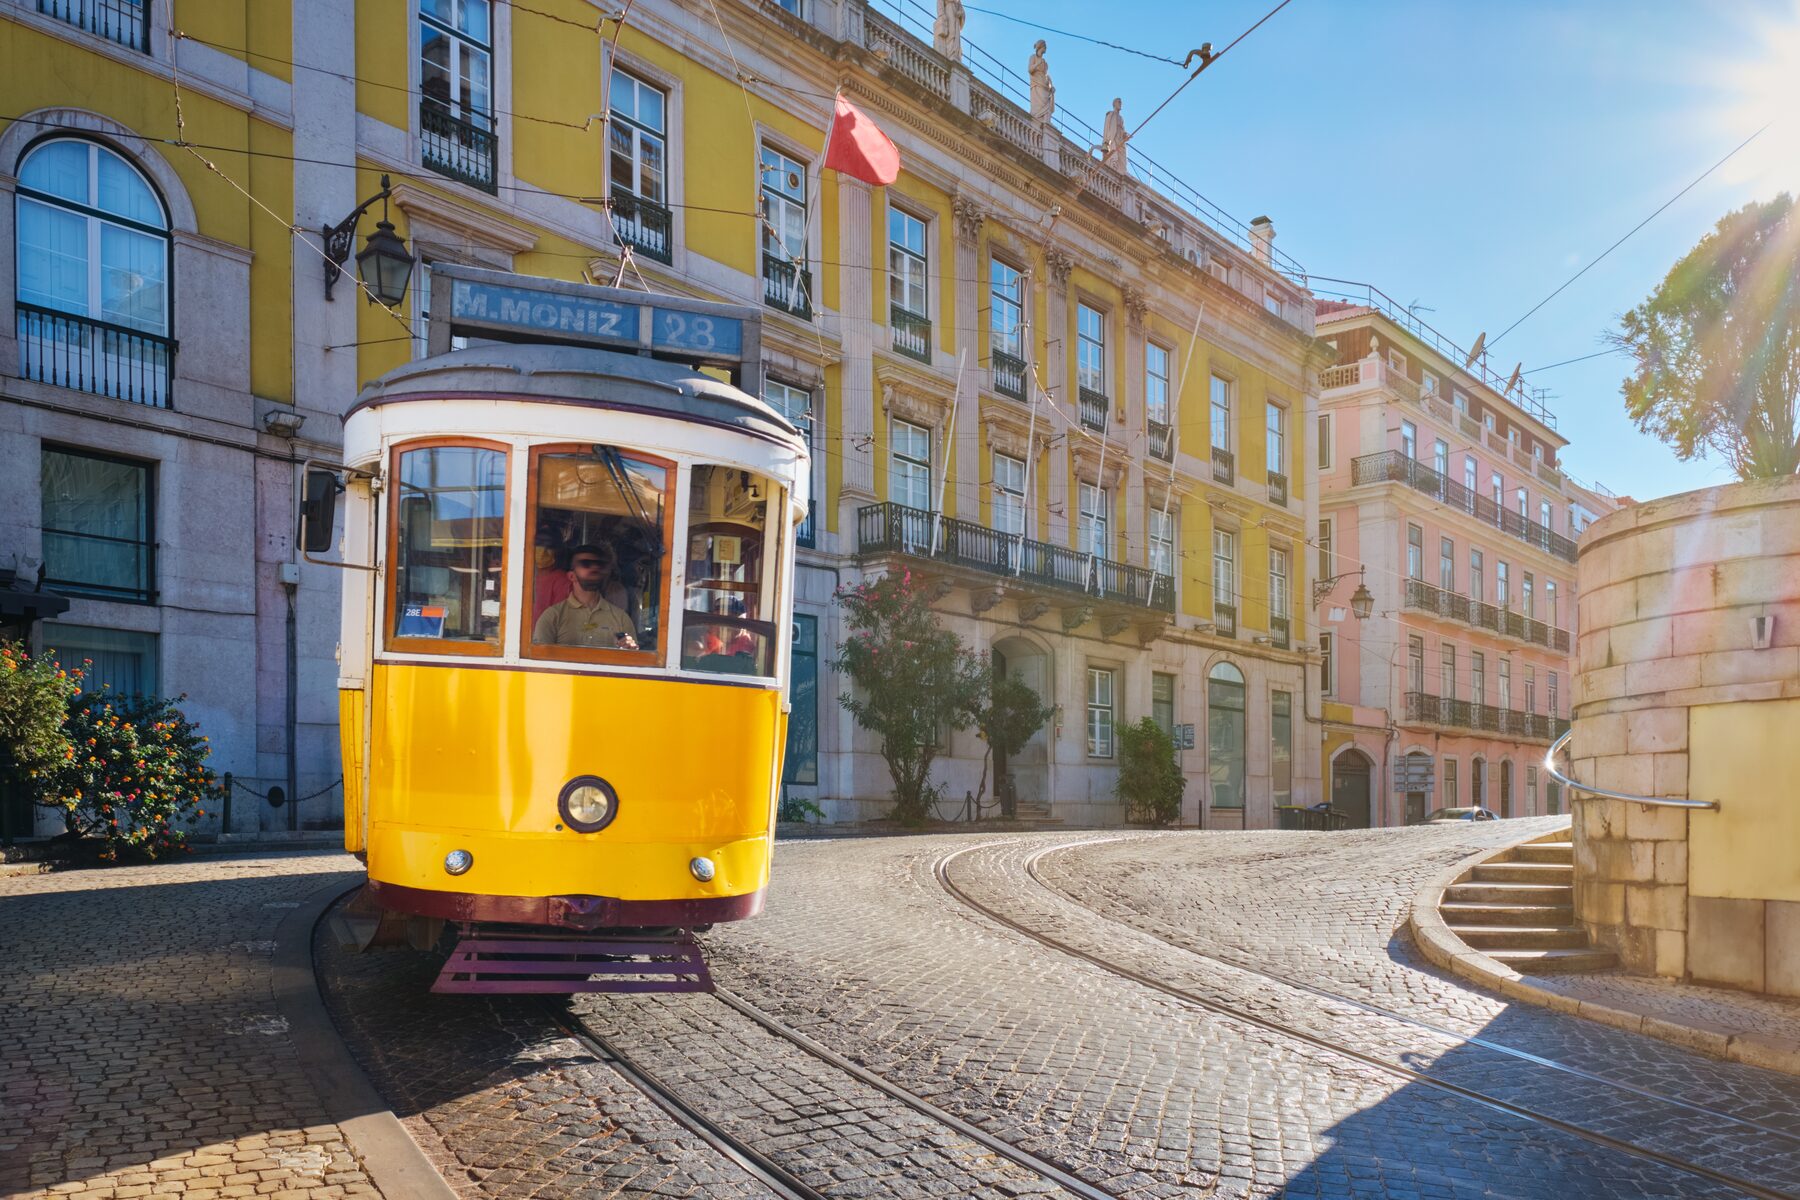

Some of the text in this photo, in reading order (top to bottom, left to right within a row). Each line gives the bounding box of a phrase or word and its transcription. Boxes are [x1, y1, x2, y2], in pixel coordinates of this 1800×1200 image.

[456, 286, 622, 337] M.MONIZ
[664, 312, 716, 352] 28
[405, 608, 421, 617] 28E
